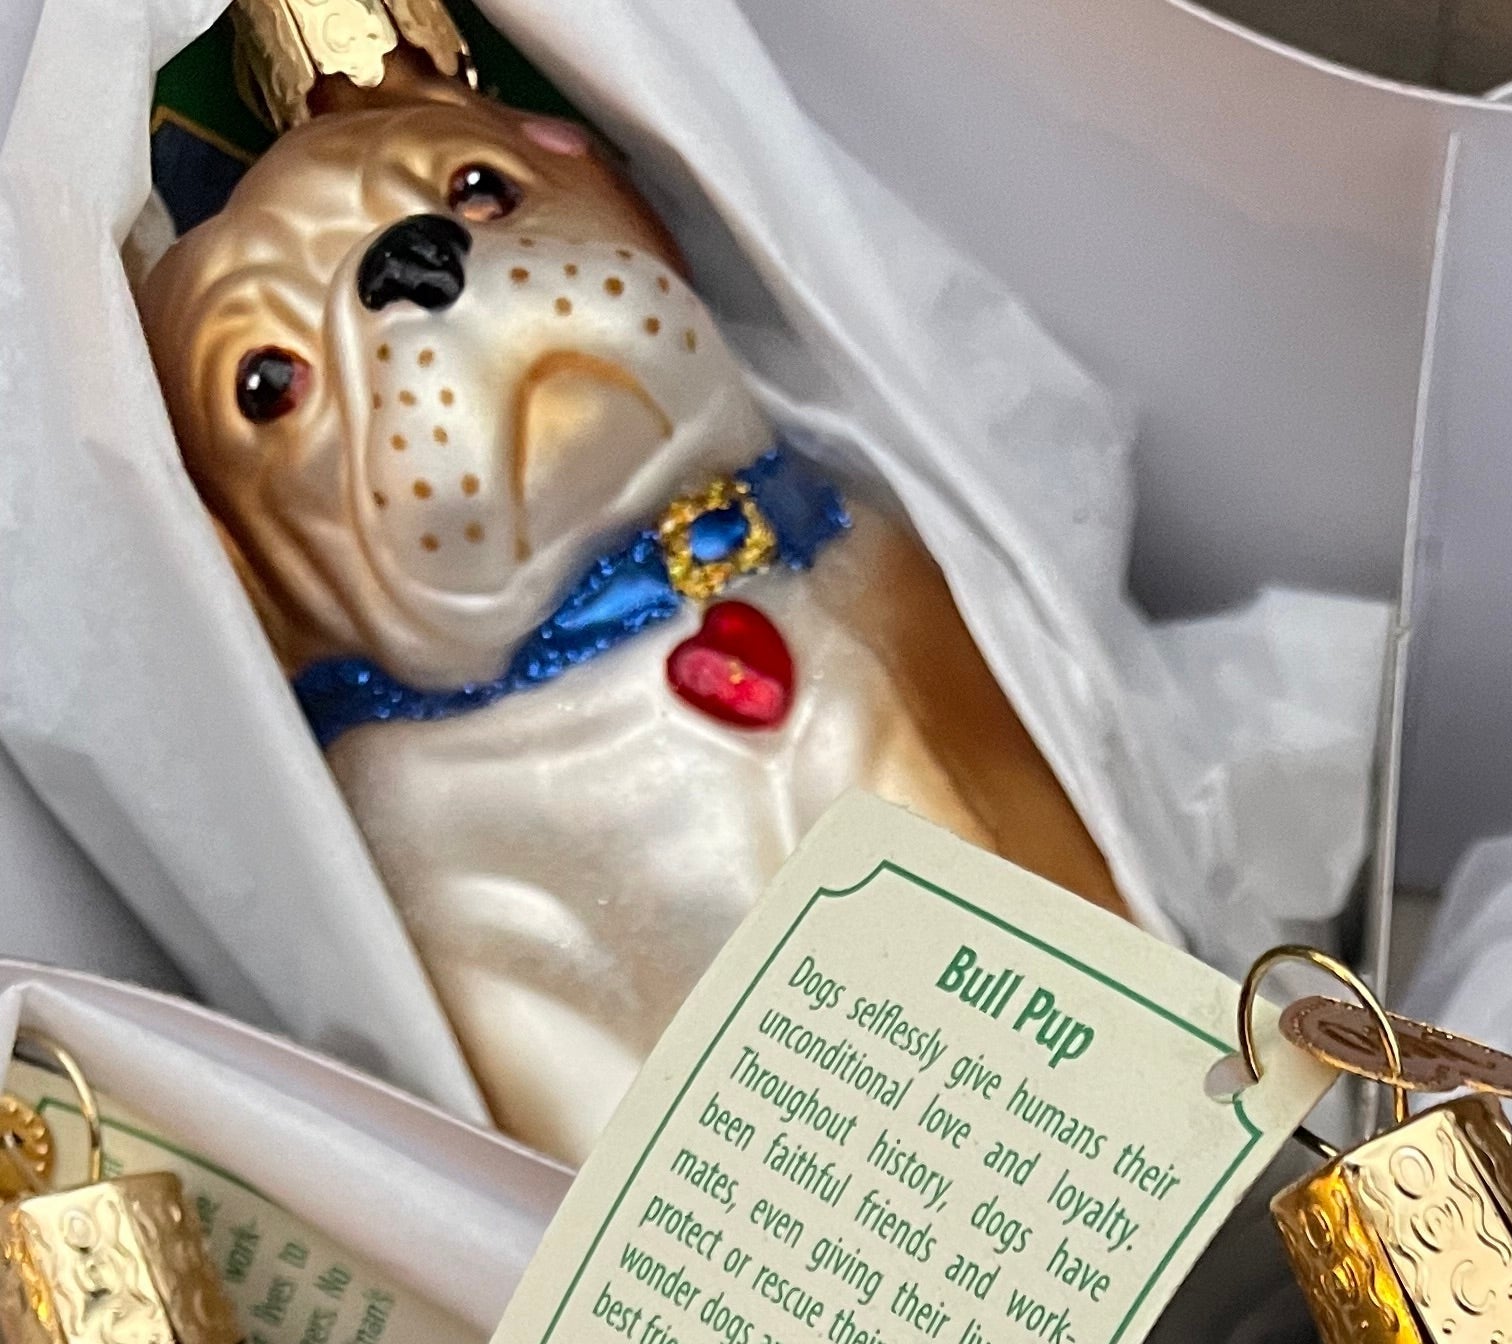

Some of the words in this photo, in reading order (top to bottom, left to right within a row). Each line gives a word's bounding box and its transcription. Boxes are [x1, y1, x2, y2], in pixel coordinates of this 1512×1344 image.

[787, 955, 847, 1011] Dogs
[846, 996, 949, 1073] selflessly
[943, 1054, 1002, 1101] give
[1005, 1076, 1108, 1160] humans
[1112, 1143, 1181, 1201] their
[934, 944, 1026, 1020] Bull
[1011, 986, 1095, 1070] Pup
[698, 1091, 756, 1152] been
[762, 1132, 853, 1208] faithful
[853, 1189, 937, 1263] friends
[944, 1253, 1002, 1301] and
[729, 1045, 858, 1147] Throughout
[866, 1128, 954, 1213] history,
[970, 1194, 1034, 1255] dogs
[1045, 1236, 1111, 1303] have
[758, 1008, 915, 1111] unconditional
[917, 1092, 972, 1150] love
[983, 1141, 1042, 1187] and
[1046, 1168, 1140, 1254] loyalty.
[591, 1281, 643, 1340] best
[619, 1242, 702, 1312] wonder
[637, 1195, 724, 1262] protect
[723, 1247, 753, 1279] or
[751, 1265, 825, 1328] rescue
[670, 1148, 740, 1214] mates,
[749, 1198, 805, 1249] even
[805, 1237, 885, 1306] giving
[890, 1281, 951, 1339] their
